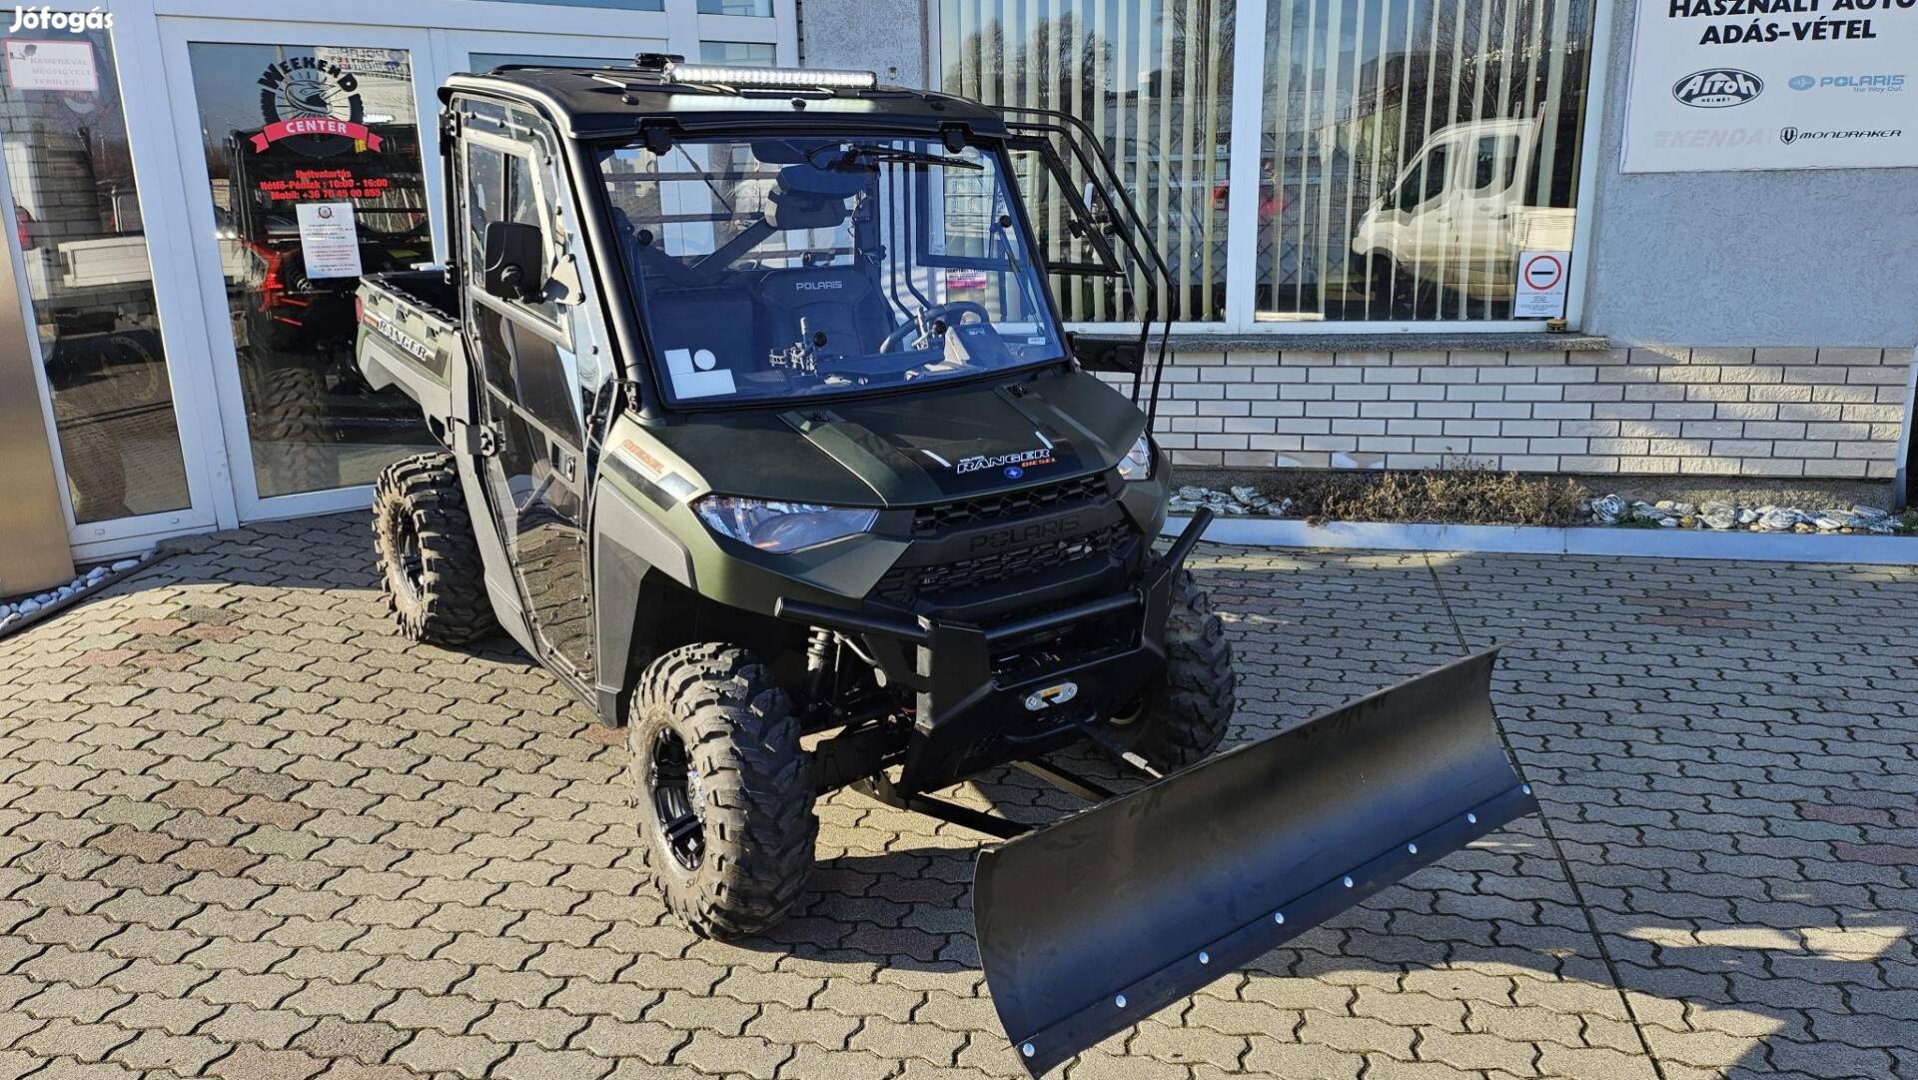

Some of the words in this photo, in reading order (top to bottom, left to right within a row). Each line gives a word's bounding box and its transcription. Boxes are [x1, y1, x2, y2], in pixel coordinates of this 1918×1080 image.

[1699, 15, 1876, 45] ADÁS-VÉTEL
[257, 56, 358, 92] WEEKEND
[1820, 75, 1905, 87] POLARIS
[286, 120, 347, 134] CENTER
[1668, 128, 1764, 148] KENDA
[1799, 129, 1902, 140] MONDRAKER
[795, 280, 843, 291] POLARIS
[377, 319, 428, 361] RANGER
[957, 448, 1050, 474] RANGER
[969, 516, 1080, 552] POLARIS
